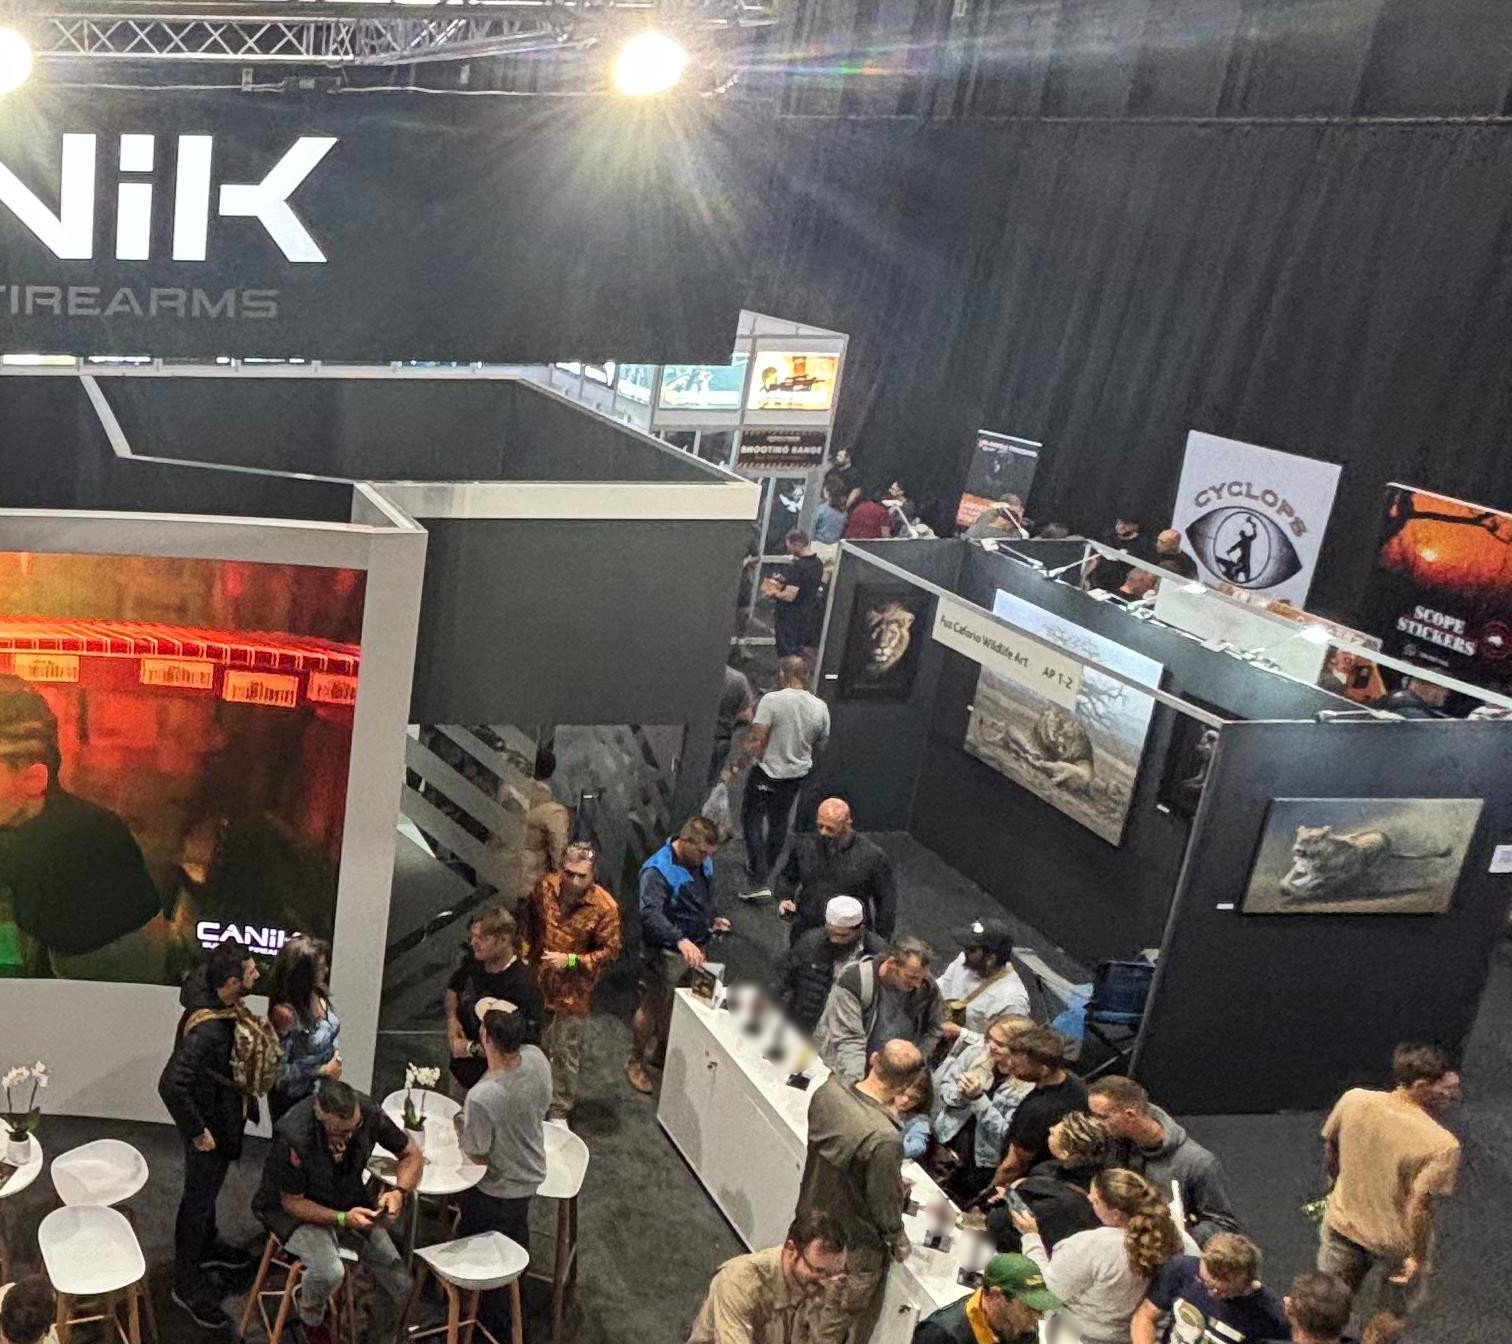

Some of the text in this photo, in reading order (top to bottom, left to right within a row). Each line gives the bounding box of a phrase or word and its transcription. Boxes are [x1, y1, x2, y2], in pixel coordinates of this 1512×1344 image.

[740, 444, 823, 455] SHOOTING RANGE
[1194, 480, 1308, 538] CYCLOPS
[1396, 616, 1476, 656] STICKERS
[1414, 605, 1467, 635] SCOPE
[982, 634, 1013, 660] Wildlife
[1014, 651, 1029, 668] Art
[1042, 666, 1057, 680] AP
